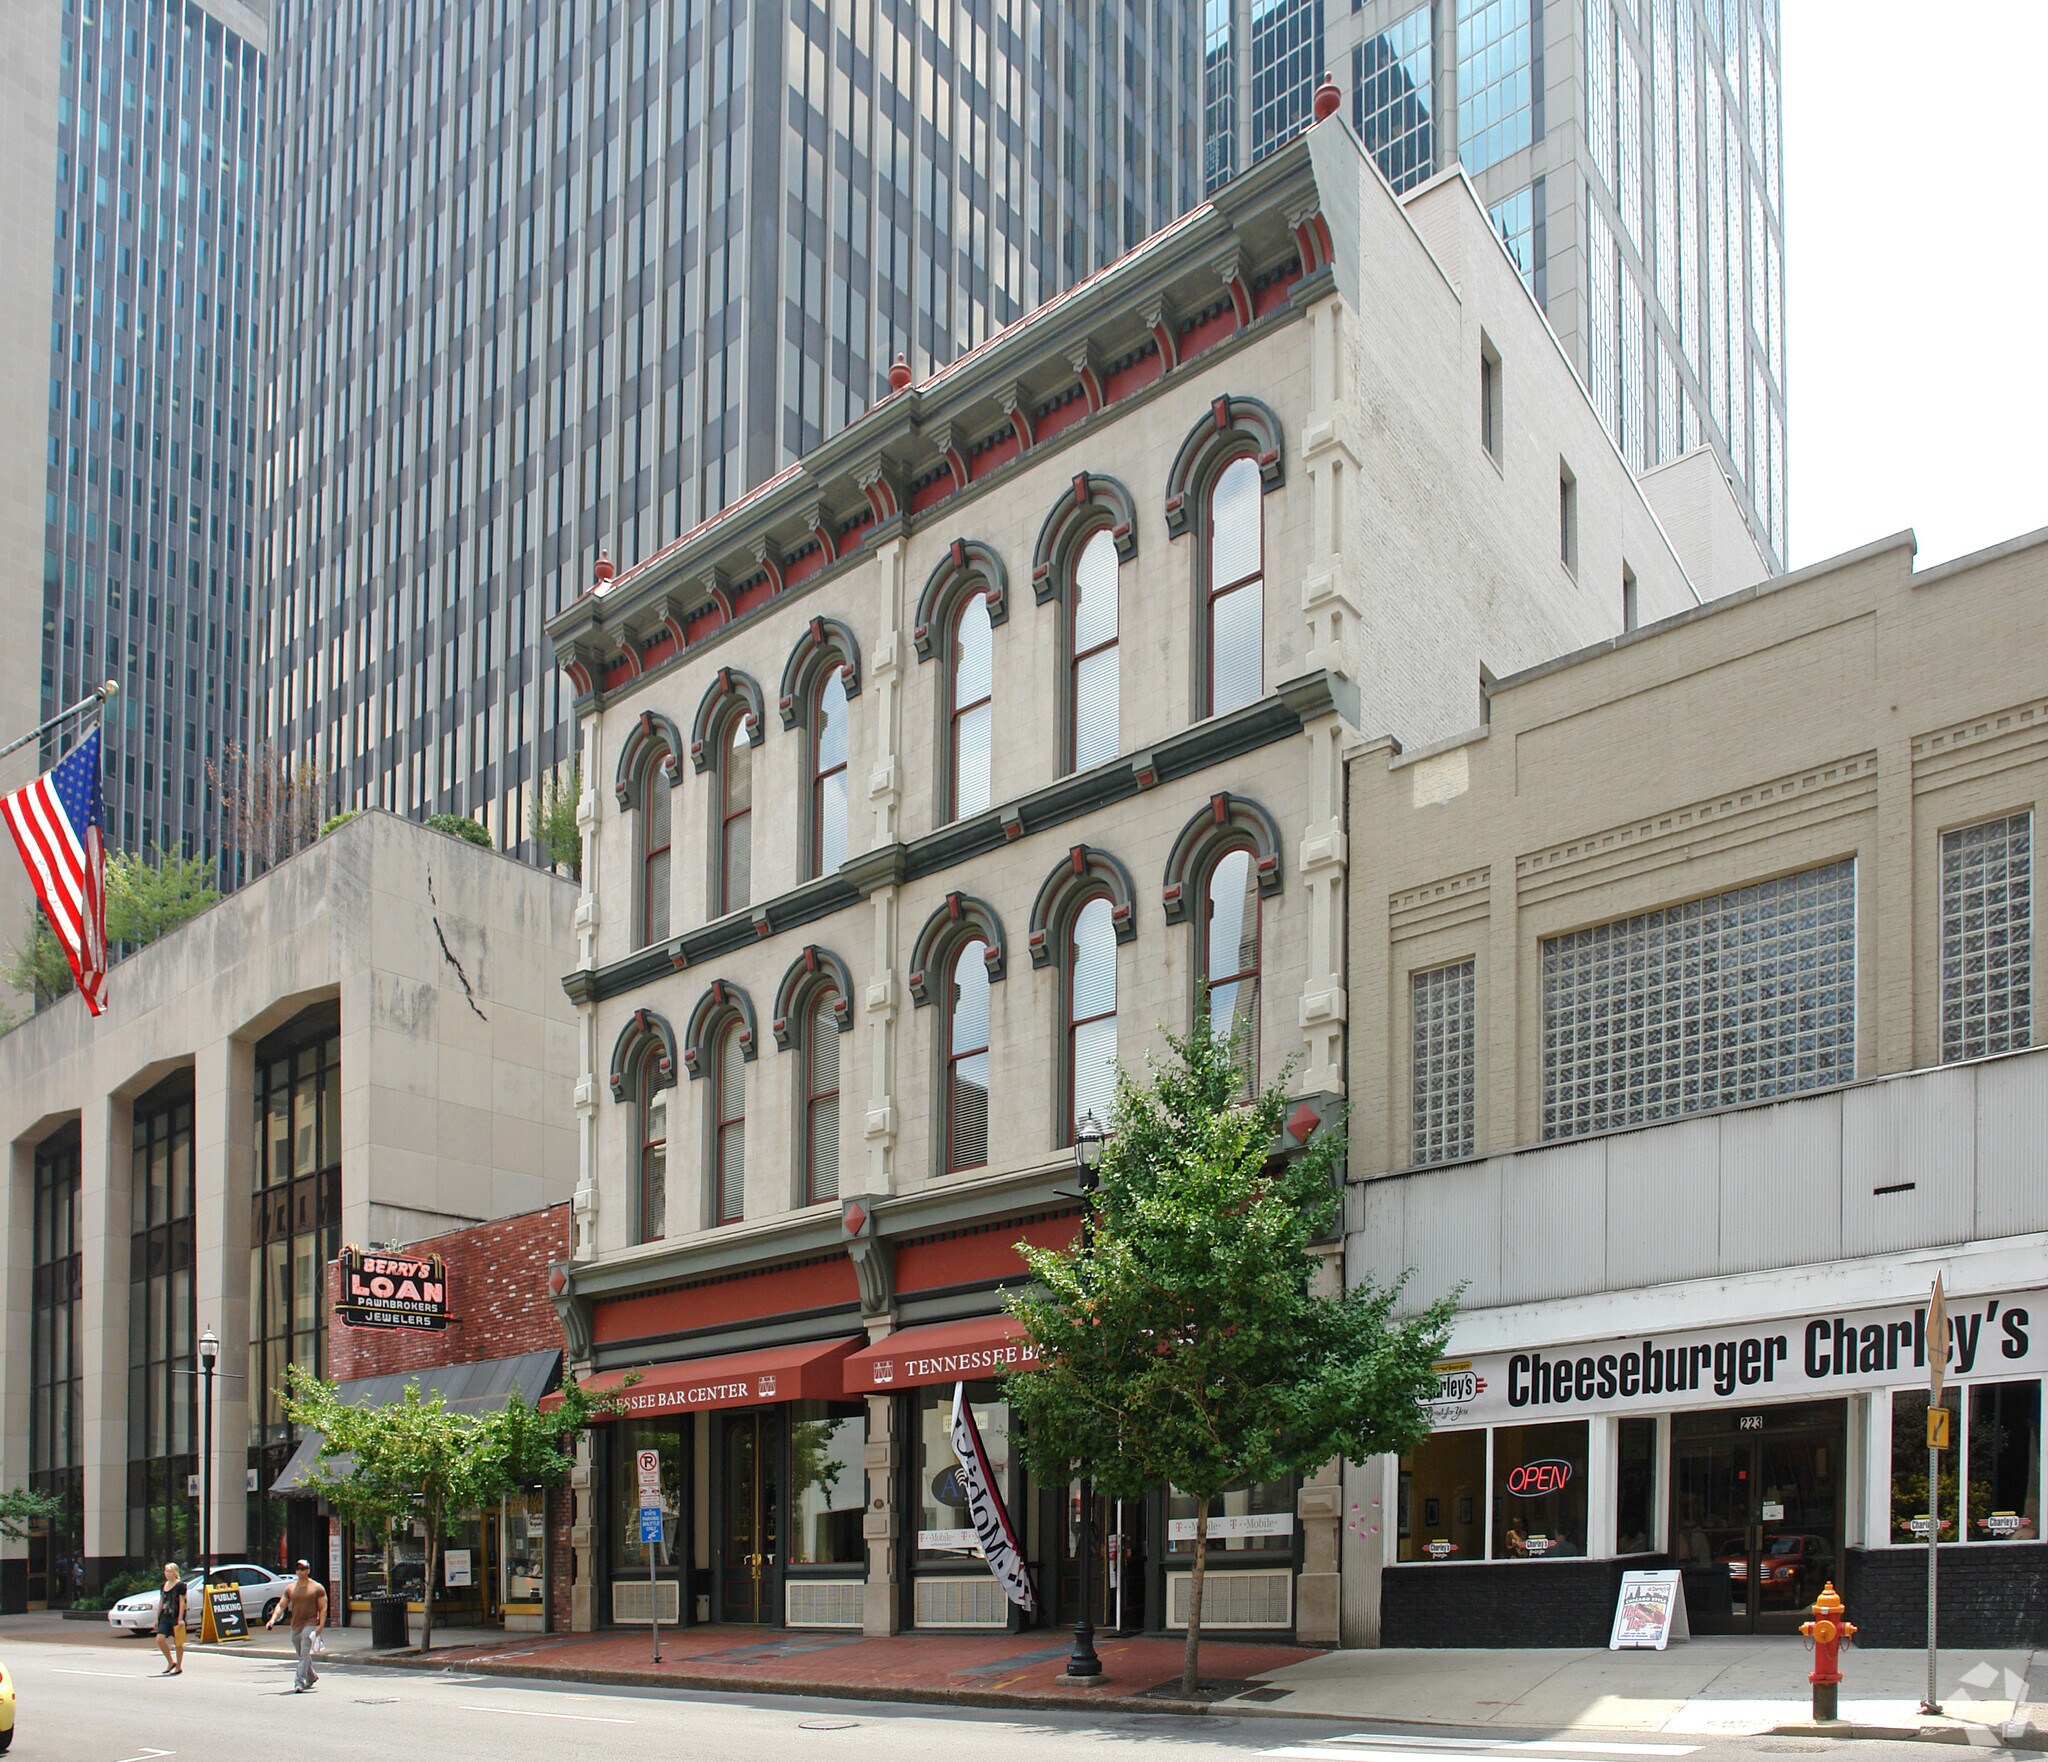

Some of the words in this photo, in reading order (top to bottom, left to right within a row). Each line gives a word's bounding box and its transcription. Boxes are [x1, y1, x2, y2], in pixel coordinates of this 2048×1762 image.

[363, 1258, 431, 1279] BERRY'S
[351, 1274, 443, 1303] LOAN
[357, 1297, 438, 1312] PAWNBROKERS
[365, 1312, 431, 1326] JEWELERS
[905, 1346, 1018, 1377] TENNESSEE
[1508, 1340, 1788, 1408] Cheeseburger
[658, 1391, 686, 1406] BAR
[687, 1382, 748, 1403] CENTER
[1741, 1416, 1762, 1430] 223
[1509, 1465, 1568, 1491] OPEN
[1989, 1516, 2018, 1526] Charley's
[1430, 1543, 1450, 1553] Charley's
[1526, 1539, 1548, 1549] Charley's
[213, 1592, 238, 1602] PUBLIC
[213, 1602, 242, 1614] PARKING
